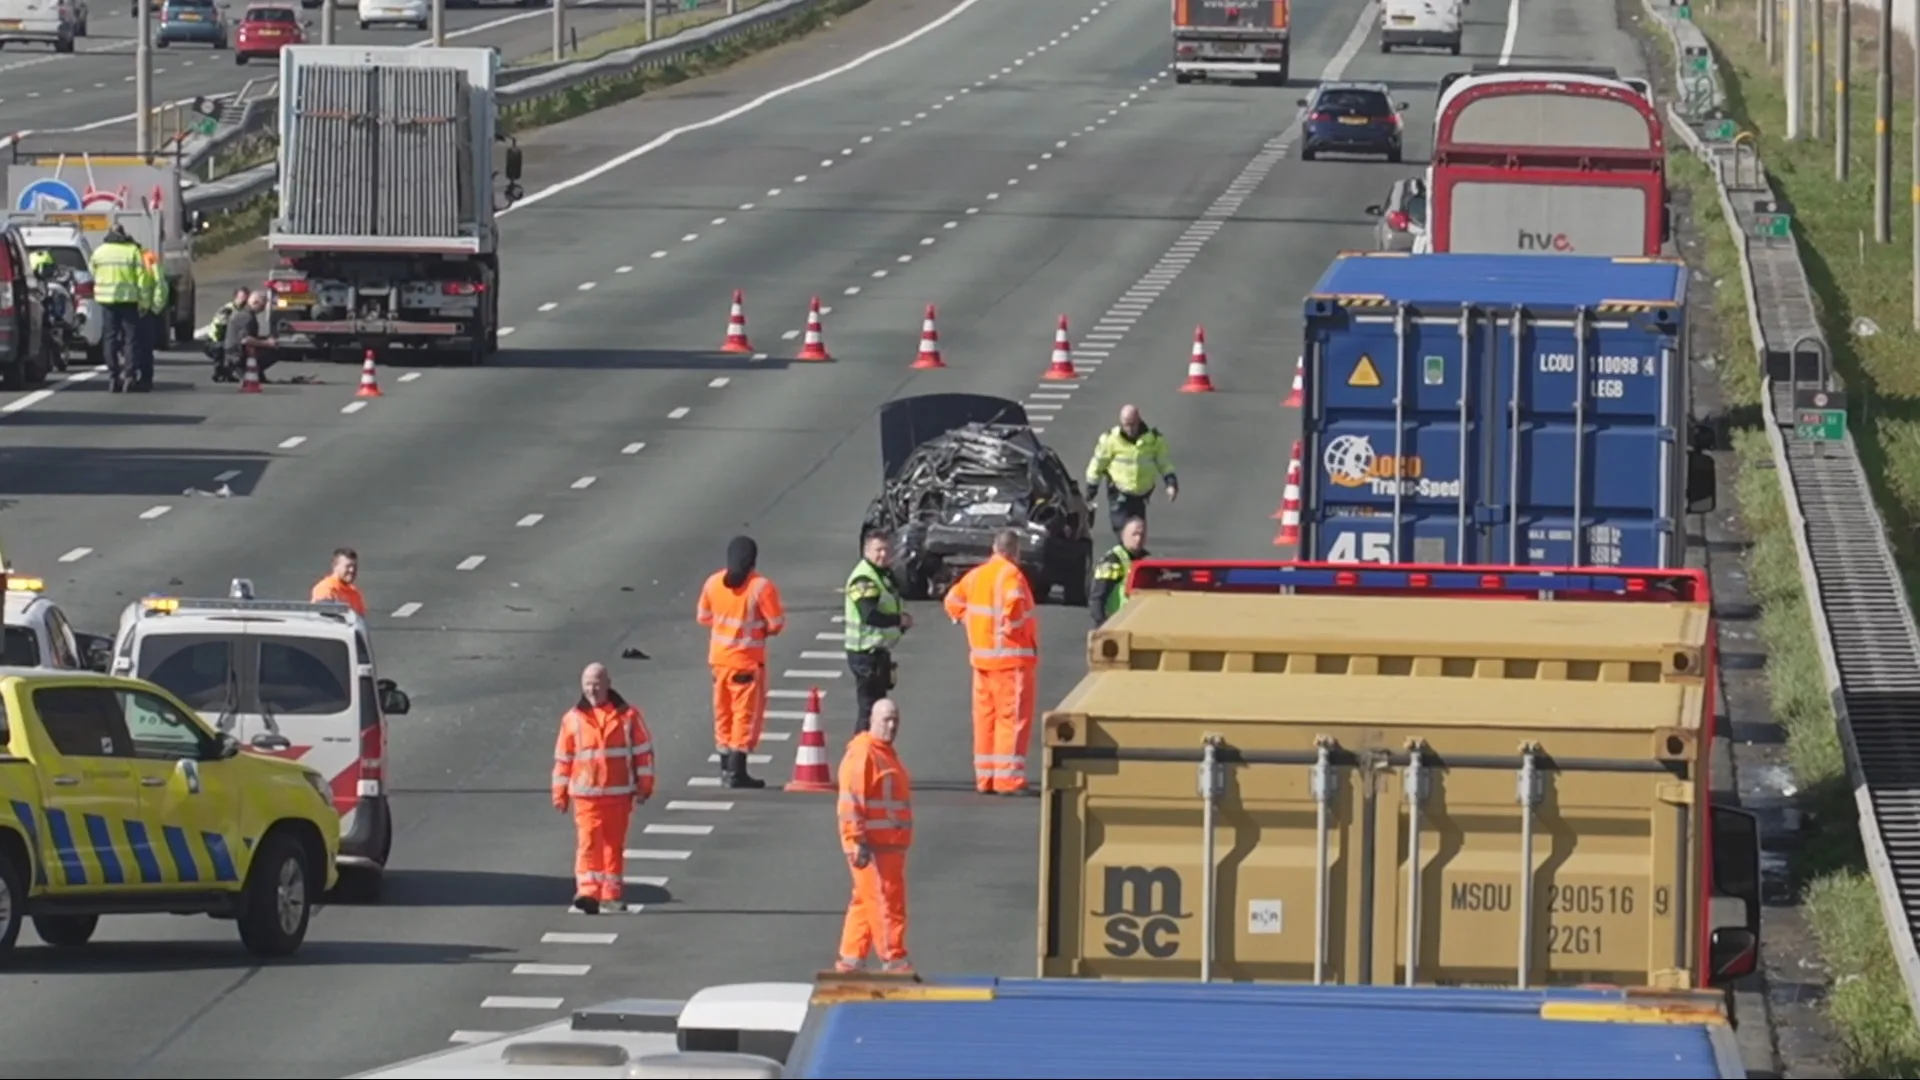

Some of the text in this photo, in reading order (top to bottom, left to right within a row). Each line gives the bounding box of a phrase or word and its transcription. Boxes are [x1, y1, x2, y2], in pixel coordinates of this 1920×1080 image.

[1540, 353, 1574, 372] LCOU
[1642, 356, 1655, 376] 4
[1591, 379, 1624, 398] LEGB
[1327, 531, 1391, 565] 45
[1451, 882, 1670, 915] MSDU 290516 9
[1547, 925, 1603, 955] 22G1
